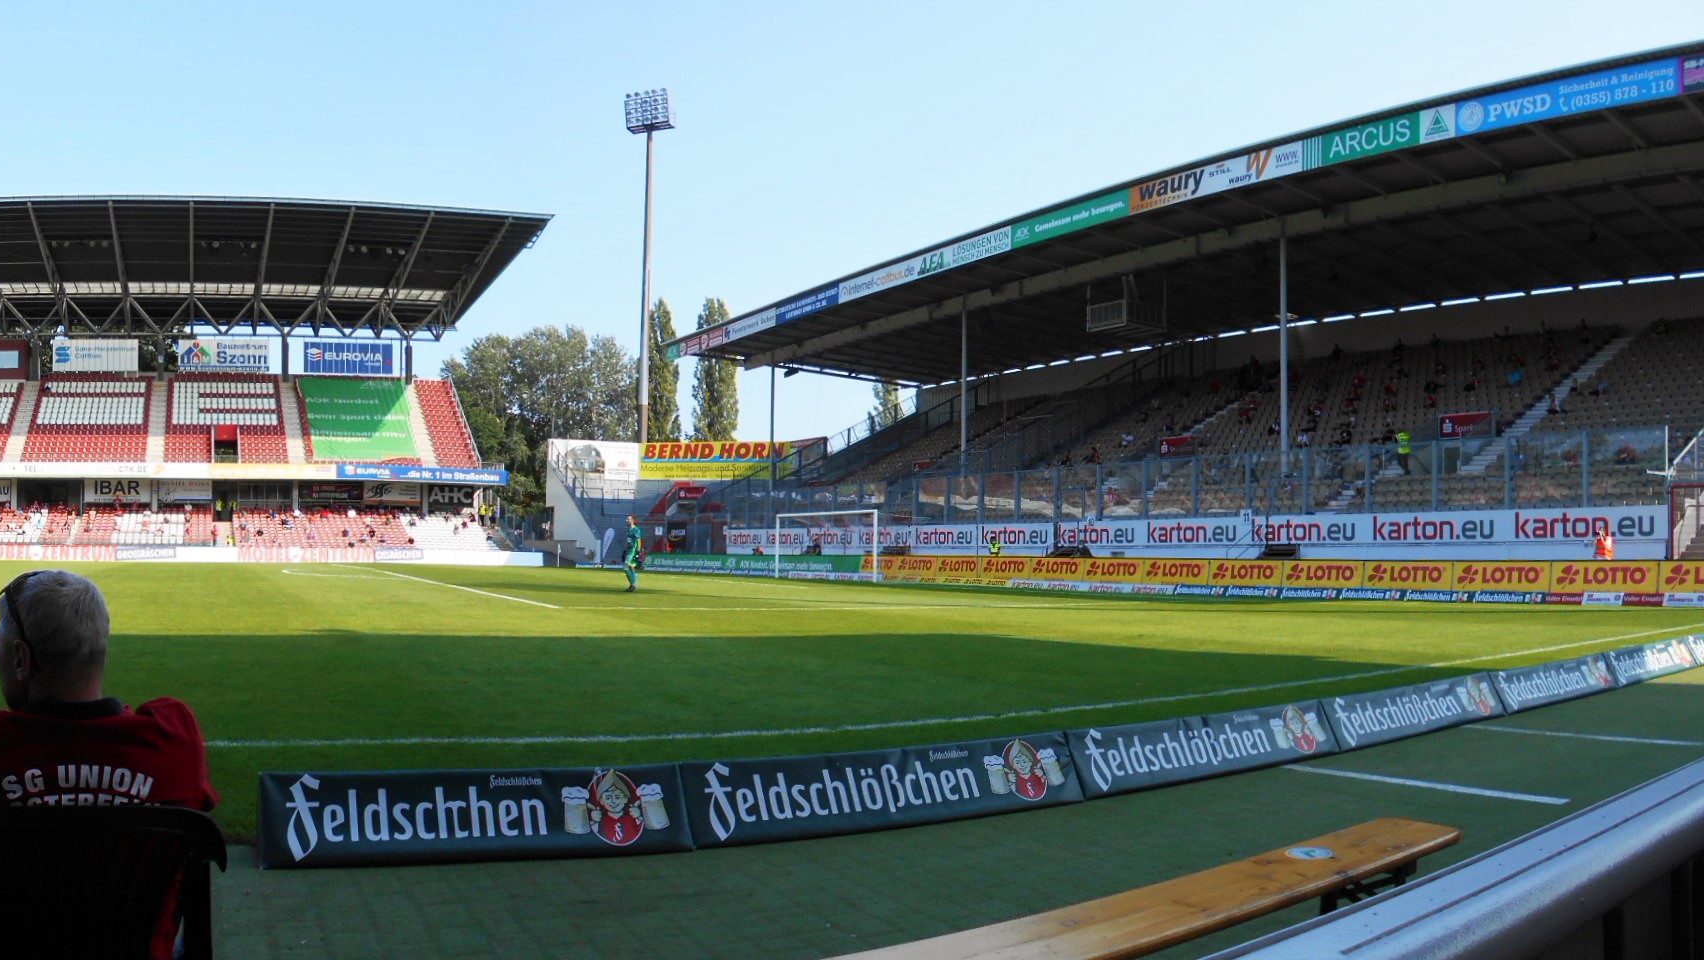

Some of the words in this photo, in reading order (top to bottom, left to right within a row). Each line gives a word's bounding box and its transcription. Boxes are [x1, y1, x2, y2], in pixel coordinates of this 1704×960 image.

[1558, 77, 1609, 95] Sicherheit
[1611, 75, 1619, 84] &
[1620, 67, 1674, 83] Reinigung
[1571, 91, 1612, 110] (0355)
[1614, 85, 1638, 99] 878
[1650, 80, 1674, 94] 110
[1487, 93, 1552, 123] PWSD
[1330, 119, 1410, 158] ARCUS
[1208, 167, 1232, 178] STILL
[1228, 173, 1253, 185] waury
[1139, 169, 1205, 202] waury
[1035, 215, 1072, 232] Gemeinsam
[1072, 210, 1090, 221] mehr
[1091, 200, 1125, 216] bewegen.
[952, 234, 993, 257] LÖSUNGEN
[993, 231, 1009, 242] VON
[216, 342, 268, 350] Bauzentrum
[216, 350, 268, 365] Szonn
[324, 352, 383, 361] EUROVIA
[644, 442, 715, 460] BERND
[719, 442, 786, 460] HORN
[422, 471, 434, 479] Nr.
[442, 472, 452, 480] im
[454, 472, 500, 481] Straßenbau
[640, 464, 674, 473] Moderne
[94, 480, 140, 495] IBAR
[429, 486, 473, 504] AHC
[915, 527, 973, 546] karton.eu
[981, 526, 1048, 546] karton.eu
[1147, 520, 1237, 544] karton.eu
[1251, 516, 1356, 543] karton.eu
[1372, 514, 1494, 542] karton.eu
[728, 530, 762, 545] karton.eu
[908, 557, 933, 571] LOTTO
[949, 560, 976, 572] LOTTO
[996, 560, 1025, 573] LOTTO
[1045, 560, 1079, 575] LOTTO
[1100, 561, 1138, 577] LOTTO
[1162, 562, 1203, 578] LOTTO
[1230, 564, 1275, 579] LOTTO
[1306, 565, 1356, 582] LOTTO
[1390, 566, 1443, 583] LOTTO
[1482, 566, 1541, 584] LOTTO
[1583, 566, 1647, 585] LOTTO
[1611, 651, 1675, 686] Feldschlößchen
[1499, 671, 1586, 710] Feldschlößchen
[1333, 697, 1461, 747] Feldschlößchen
[1084, 727, 1273, 793] Feldschlößchen
[1, 768, 46, 800] SG
[57, 763, 154, 800] UNION
[704, 762, 980, 842] Feldschlößchen
